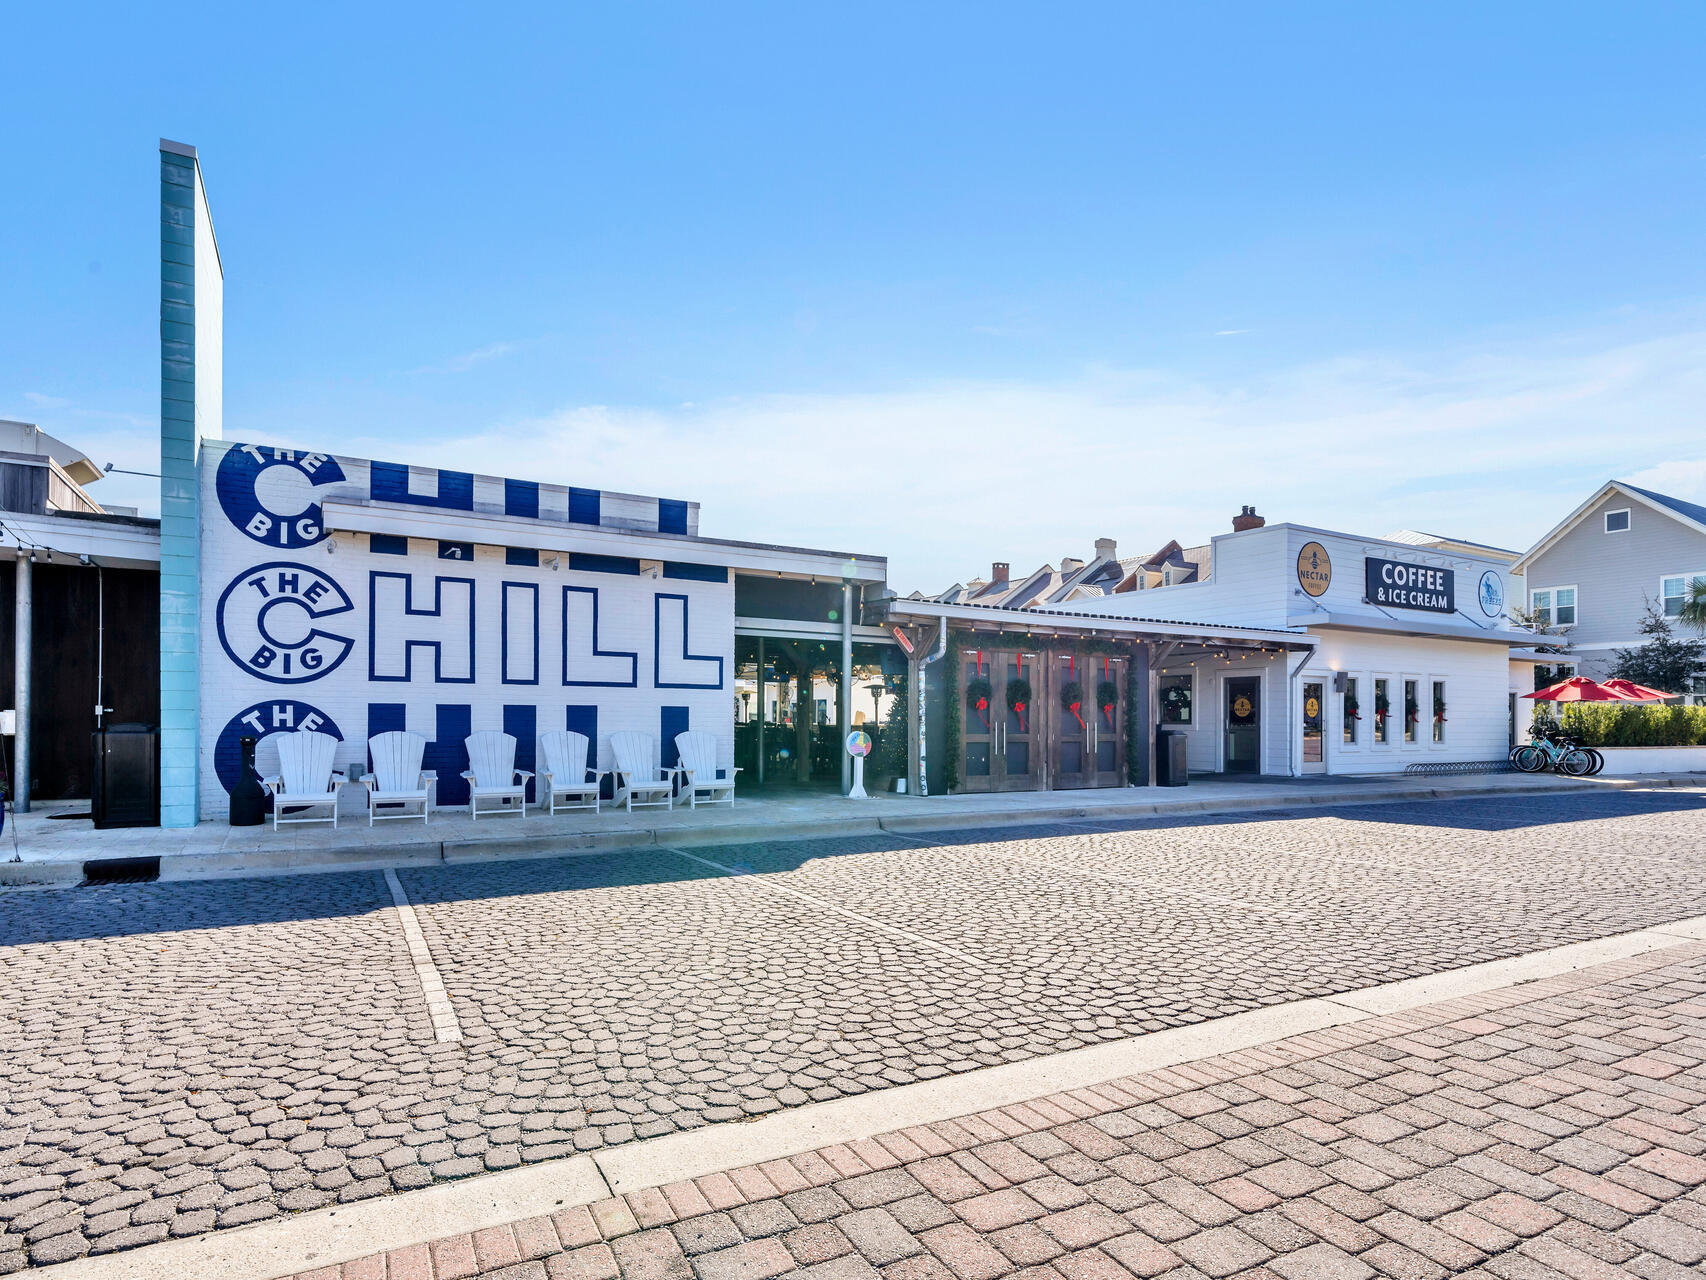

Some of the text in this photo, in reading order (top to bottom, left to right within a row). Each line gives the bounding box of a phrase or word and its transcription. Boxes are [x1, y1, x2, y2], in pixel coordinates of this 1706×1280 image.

[241, 443, 328, 474] THE
[245, 512, 319, 544] BIG
[248, 572, 329, 605] THE
[1300, 569, 1329, 582] NECTAR
[1381, 563, 1444, 591] COFFEE
[1377, 587, 1448, 609] & ICE CREAM
[249, 644, 323, 675] BIG
[241, 705, 324, 733] THE
